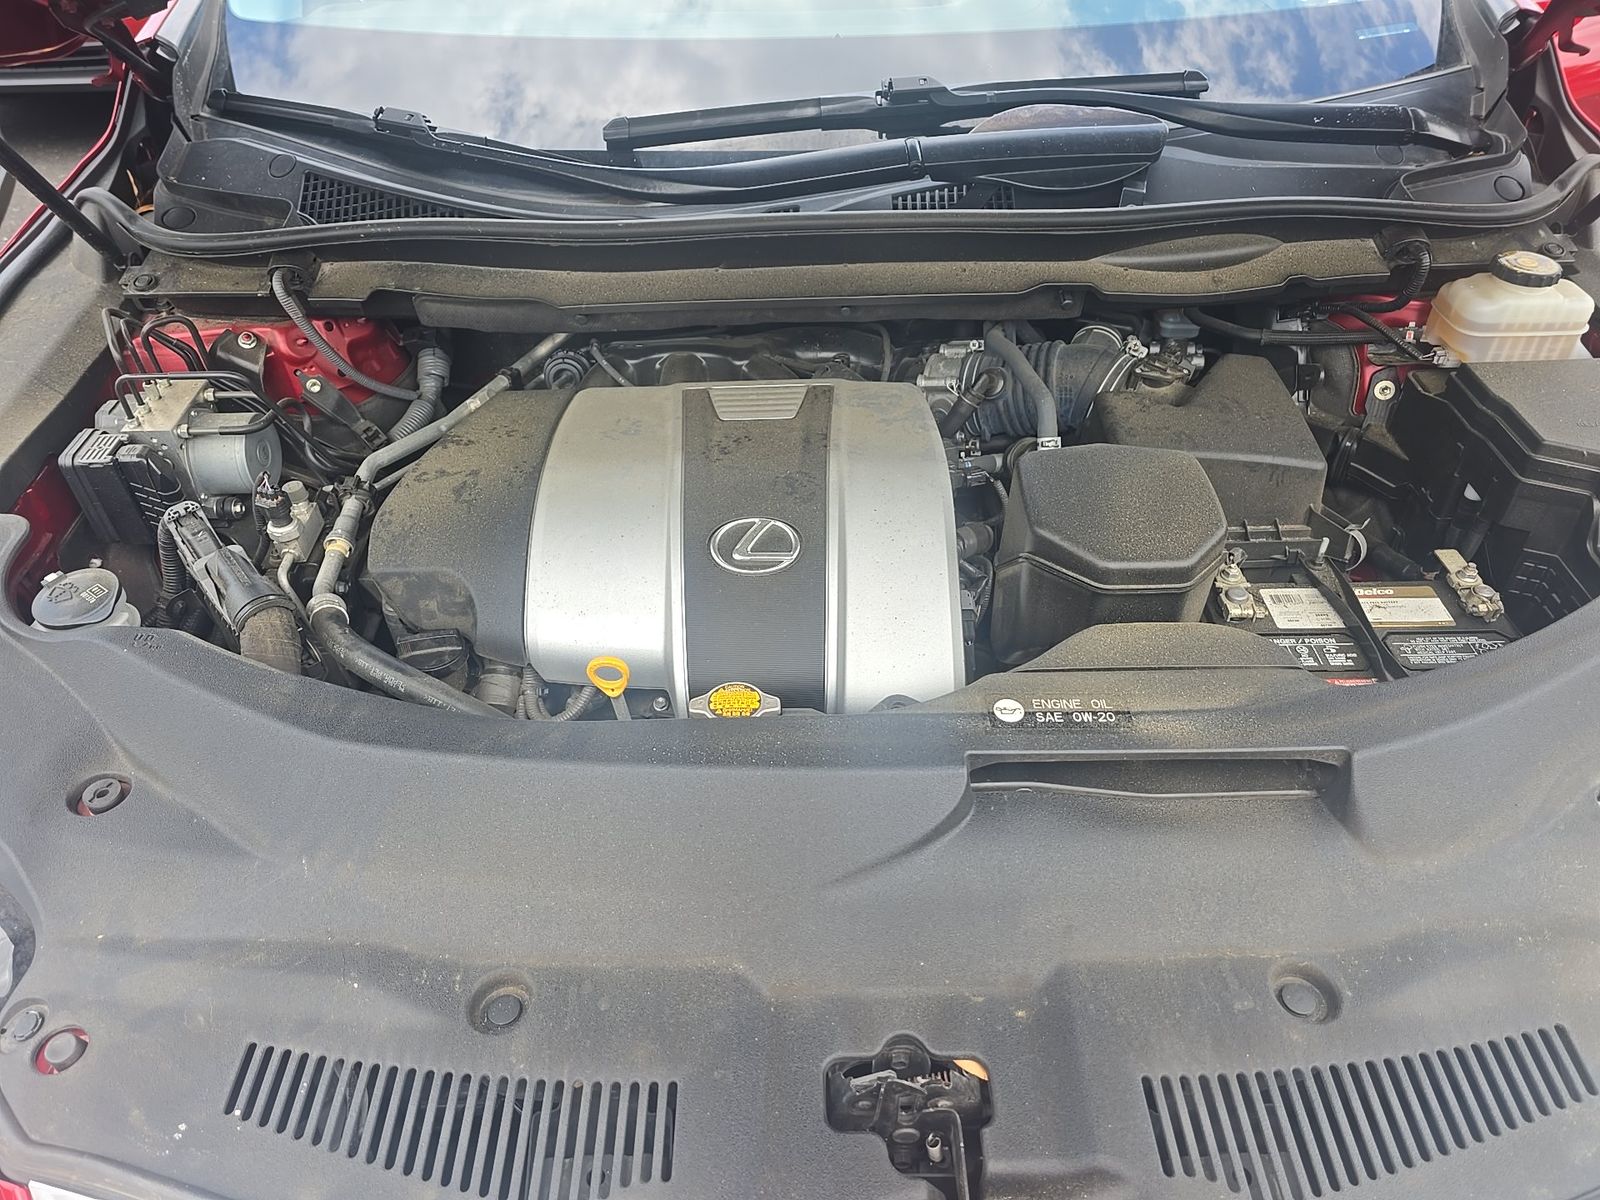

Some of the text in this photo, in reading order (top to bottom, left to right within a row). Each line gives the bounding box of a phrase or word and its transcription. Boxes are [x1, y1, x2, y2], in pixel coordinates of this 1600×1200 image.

[1303, 637, 1337, 645] POISON
[1032, 699, 1114, 709] ENGINE OIL
[1035, 711, 1116, 723] SAE 0W-20
